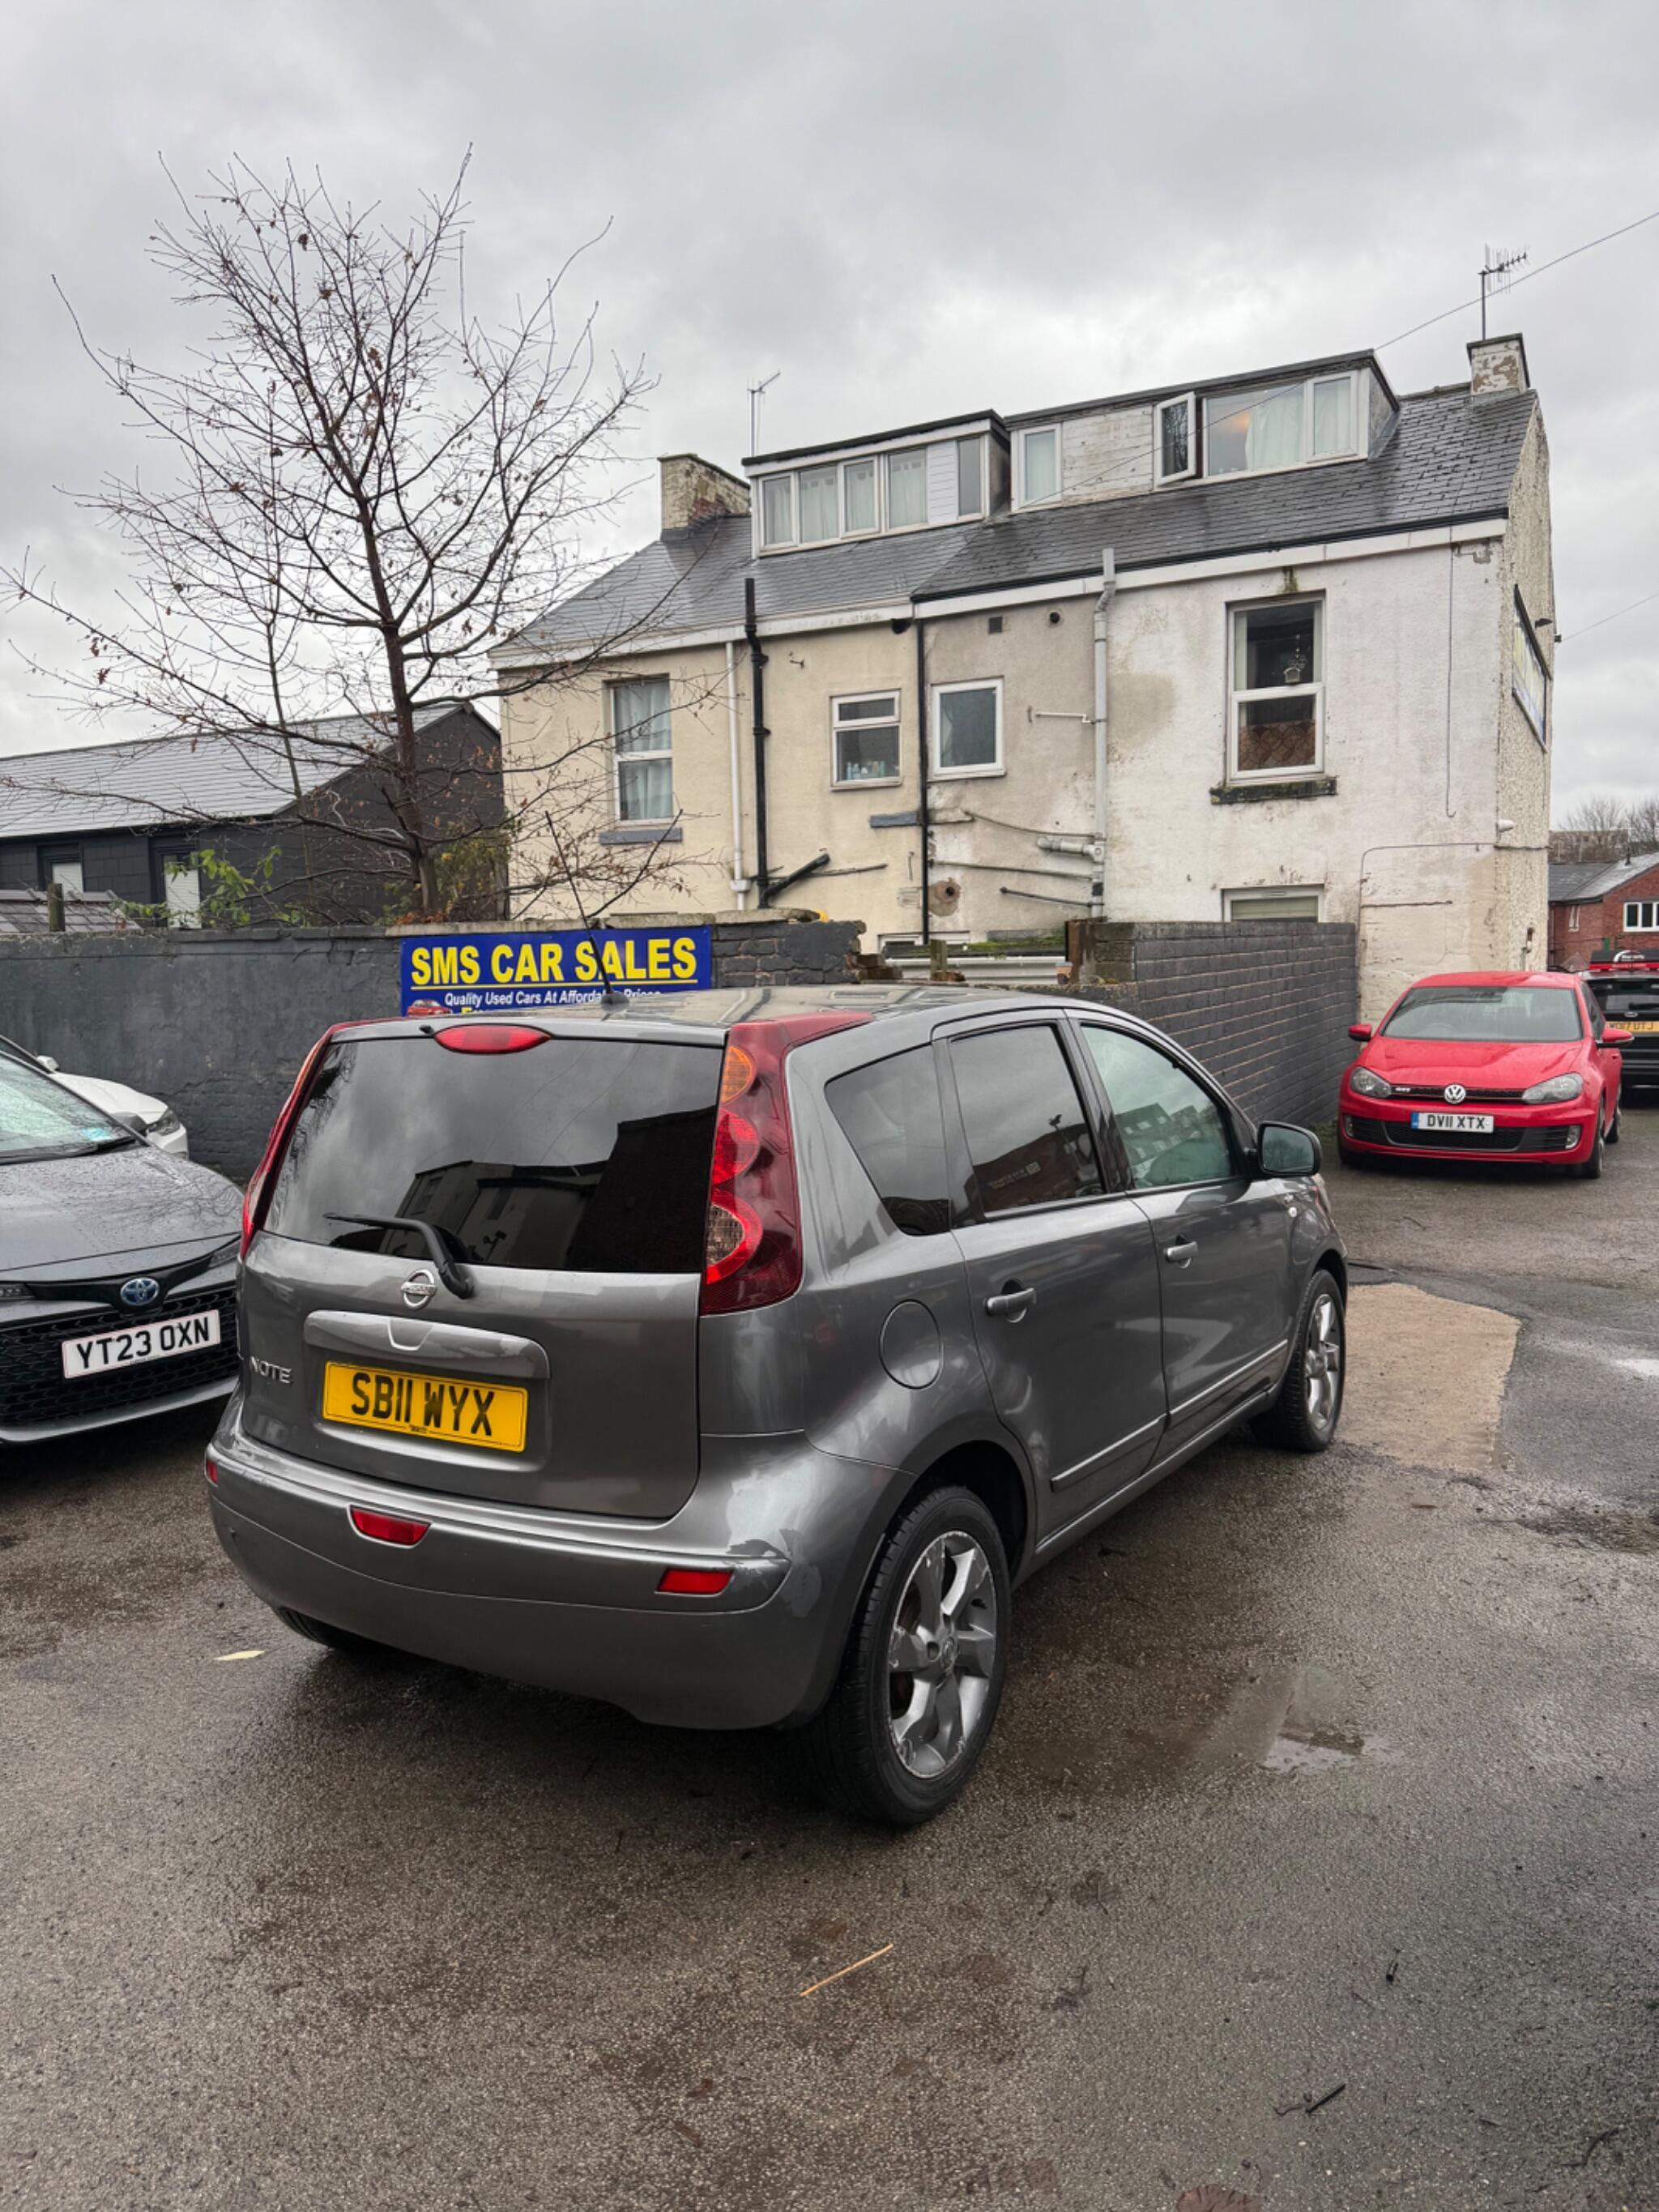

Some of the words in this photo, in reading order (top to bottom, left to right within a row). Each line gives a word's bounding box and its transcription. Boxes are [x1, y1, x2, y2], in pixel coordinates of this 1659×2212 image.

[411, 946, 480, 984] SMS
[491, 943, 565, 983] CAR
[574, 937, 697, 980] SALES
[444, 992, 482, 1008] Quality
[484, 992, 514, 1005] Used
[515, 991, 541, 1004] Cars
[544, 990, 557, 1004] At
[559, 989, 609, 1004] Afforda
[1427, 1114, 1454, 1127] DV11
[1457, 1117, 1485, 1129] XTX
[77, 1330, 151, 1369] YT23
[160, 1317, 210, 1351] OXN
[249, 1356, 292, 1384] NOTE
[351, 1372, 413, 1423] SB11
[424, 1381, 495, 1437] WYX
